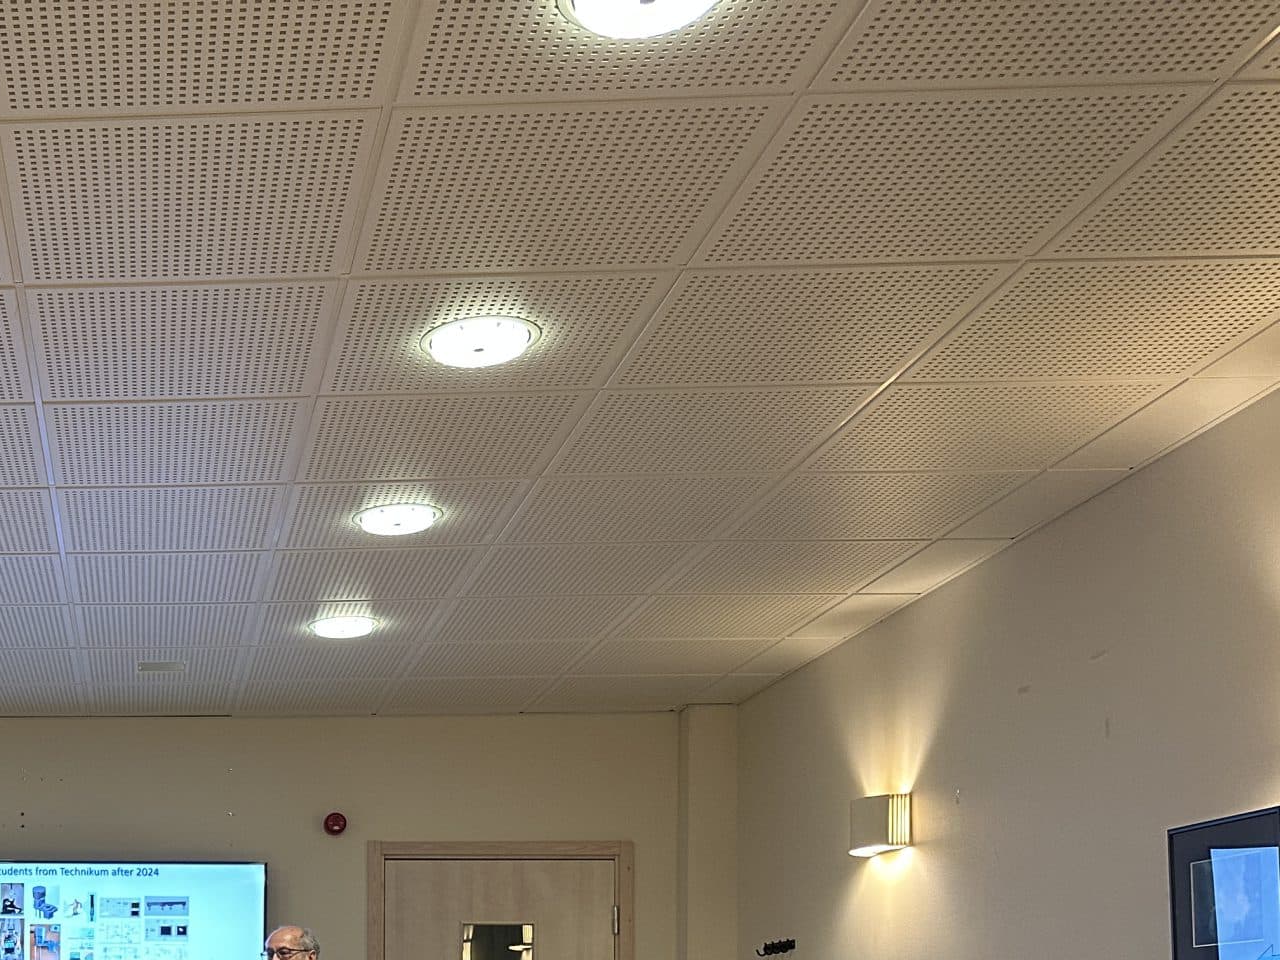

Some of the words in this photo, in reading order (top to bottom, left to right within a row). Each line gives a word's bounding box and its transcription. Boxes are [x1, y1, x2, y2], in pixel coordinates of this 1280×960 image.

[35, 867, 57, 877] from
[60, 867, 109, 877] Technikum
[111, 867, 133, 877] after
[136, 867, 160, 877] 2024
